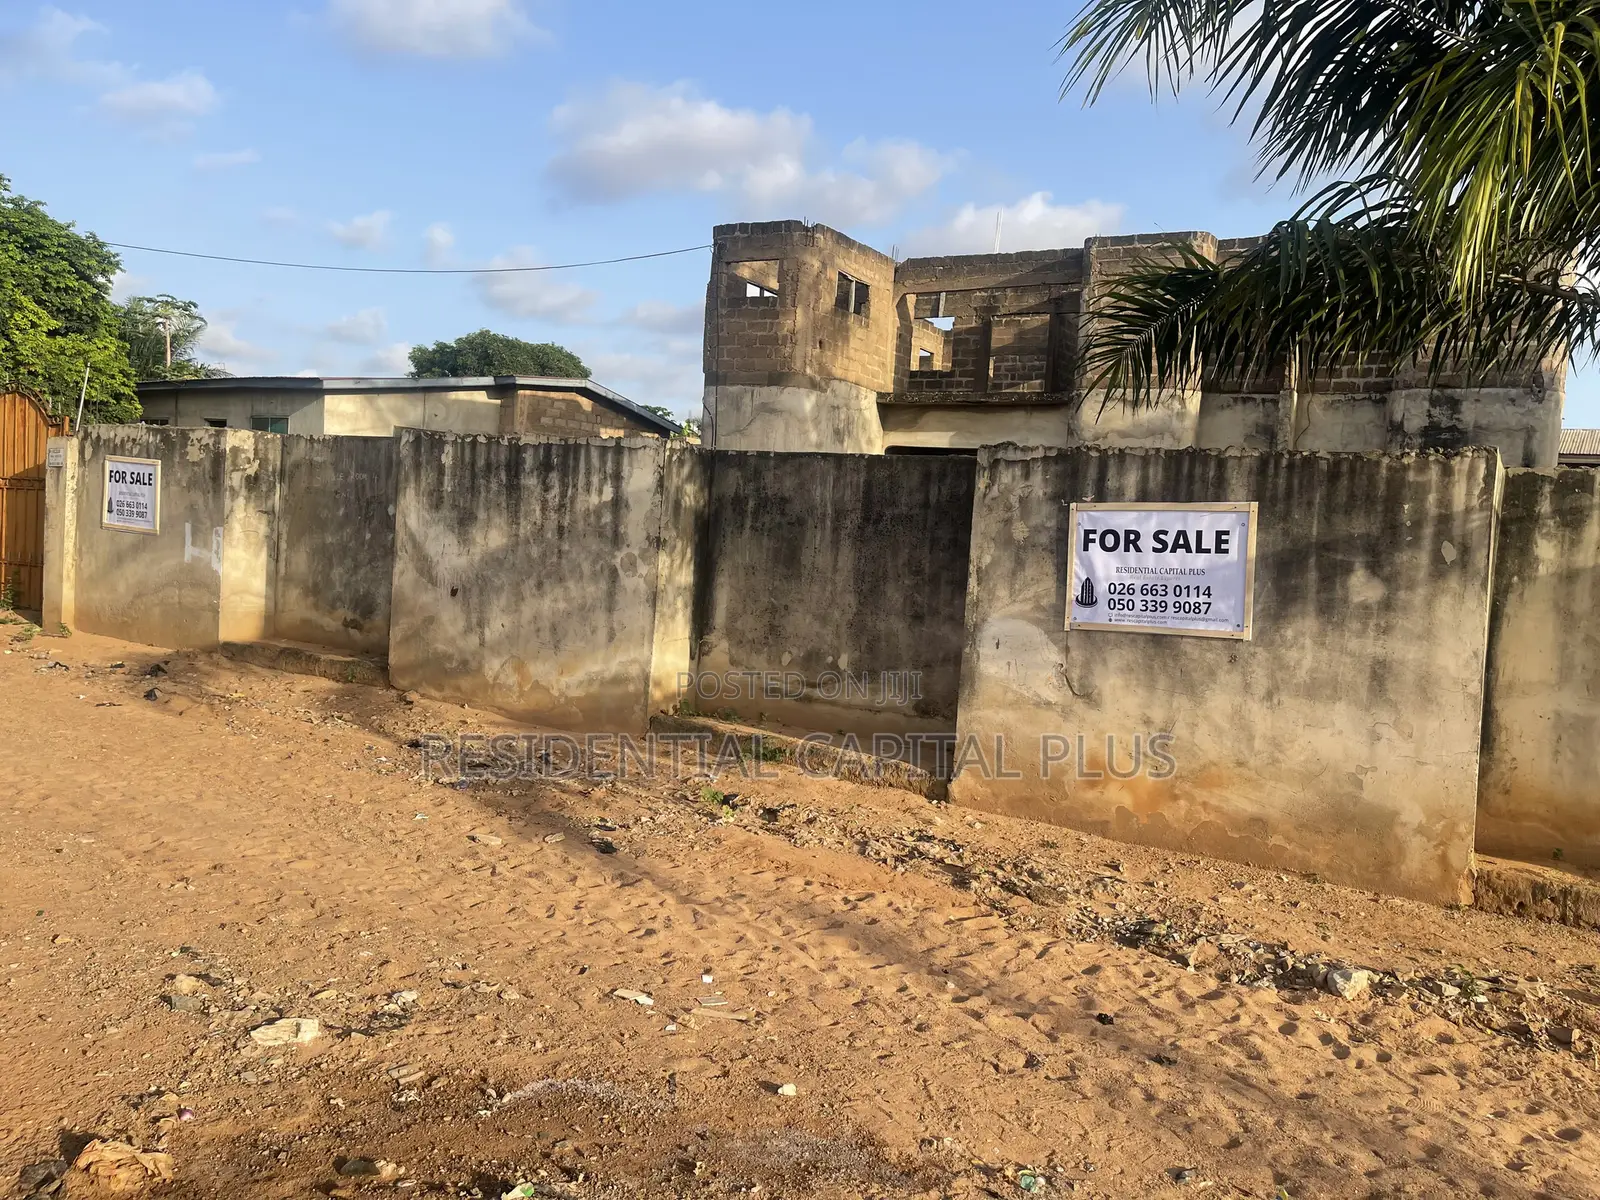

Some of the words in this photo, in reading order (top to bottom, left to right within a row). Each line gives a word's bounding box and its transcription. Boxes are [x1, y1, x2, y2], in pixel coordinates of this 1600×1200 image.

[109, 470, 127, 485] FOR
[130, 471, 153, 487] SALE
[116, 499, 125, 508] 026
[126, 501, 135, 509] 663
[136, 502, 148, 510] 0114
[116, 509, 125, 517] 050
[126, 509, 135, 518] 339
[136, 510, 148, 519] 9087
[1082, 528, 1143, 553] FOR
[1152, 529, 1231, 555] SALE
[1115, 566, 1158, 575] RESIDENTIAL
[1159, 567, 1187, 576] CAPITAL
[1188, 568, 1206, 576] PLUS
[1108, 582, 1136, 596] 026
[1140, 583, 1169, 597] 663
[1173, 585, 1213, 599] 0114
[1107, 598, 1135, 611] 050
[1139, 599, 1168, 613] 339
[1172, 601, 1212, 615] 9087
